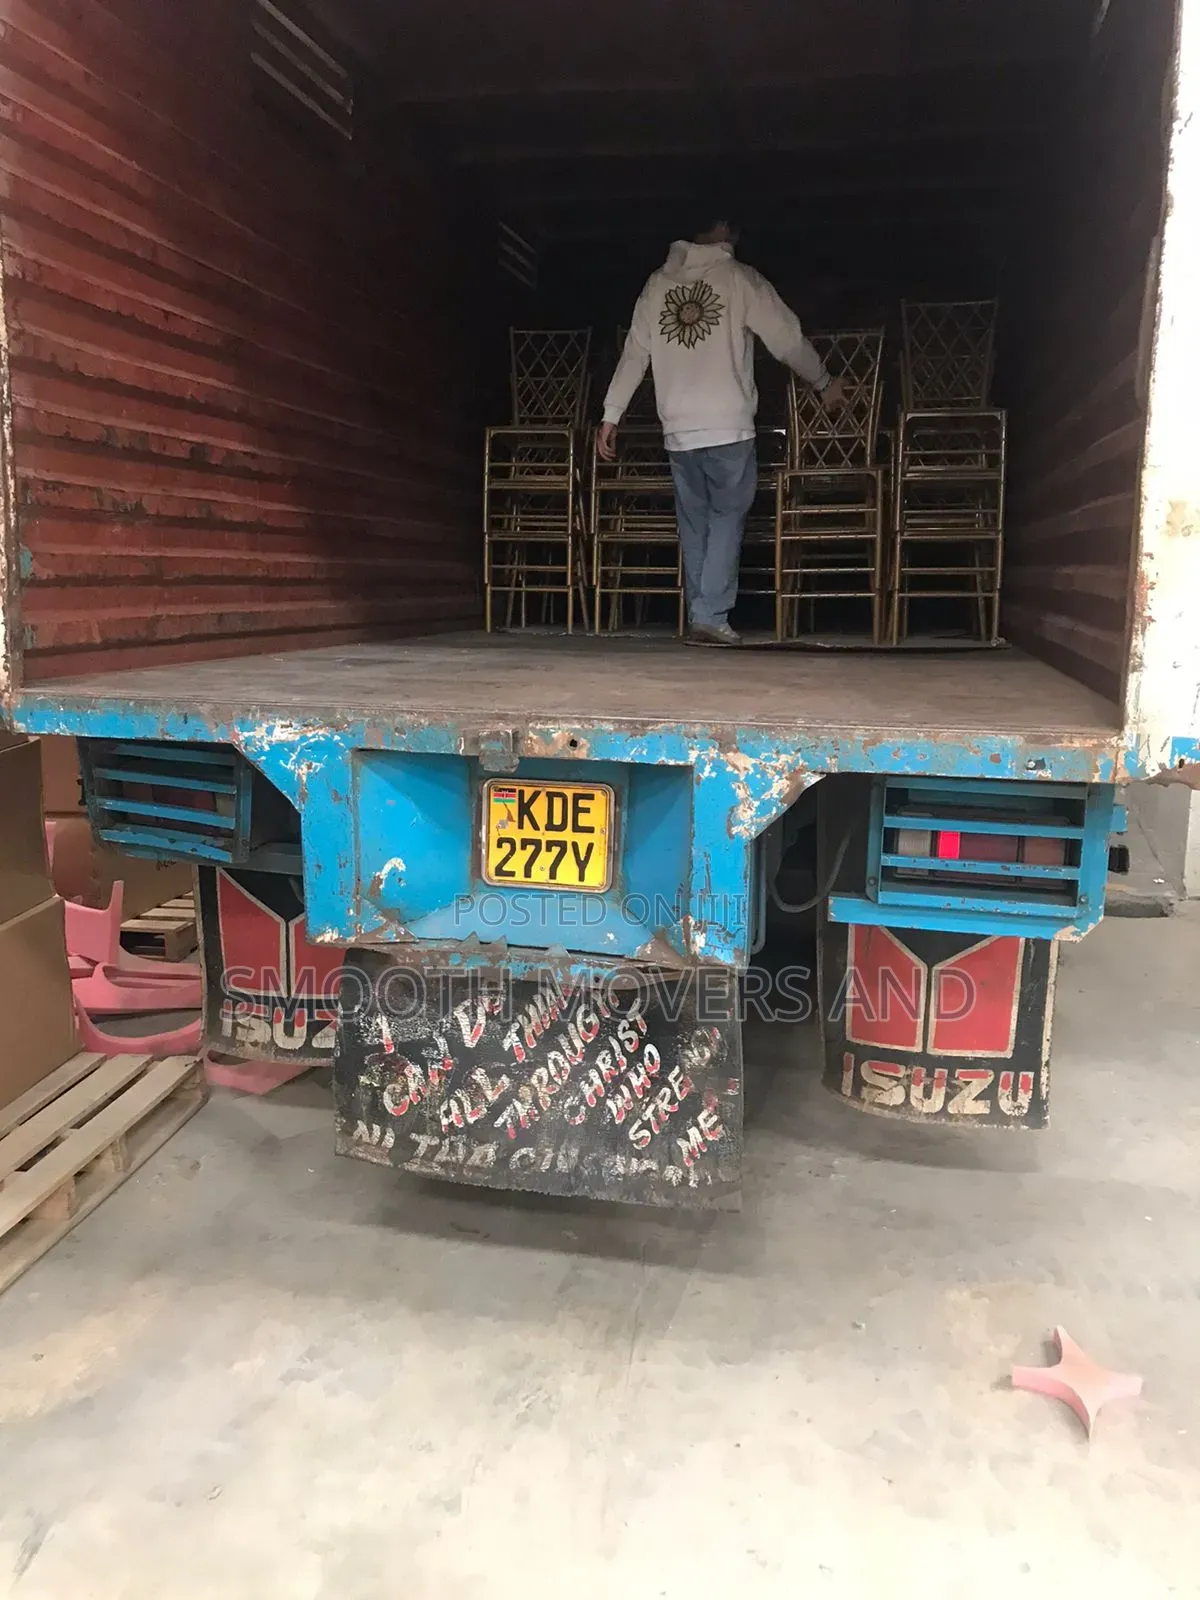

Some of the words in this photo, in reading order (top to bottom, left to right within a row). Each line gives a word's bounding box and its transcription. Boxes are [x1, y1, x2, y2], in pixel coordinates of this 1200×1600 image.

[517, 789, 595, 833] KDE
[494, 837, 595, 882] 277Y
[221, 998, 338, 1050] ISUZ
[563, 997, 648, 1127] CHRIST
[606, 1043, 661, 1125] WHO
[841, 1052, 1035, 1117] ISUZU
[676, 1108, 723, 1168] ME
